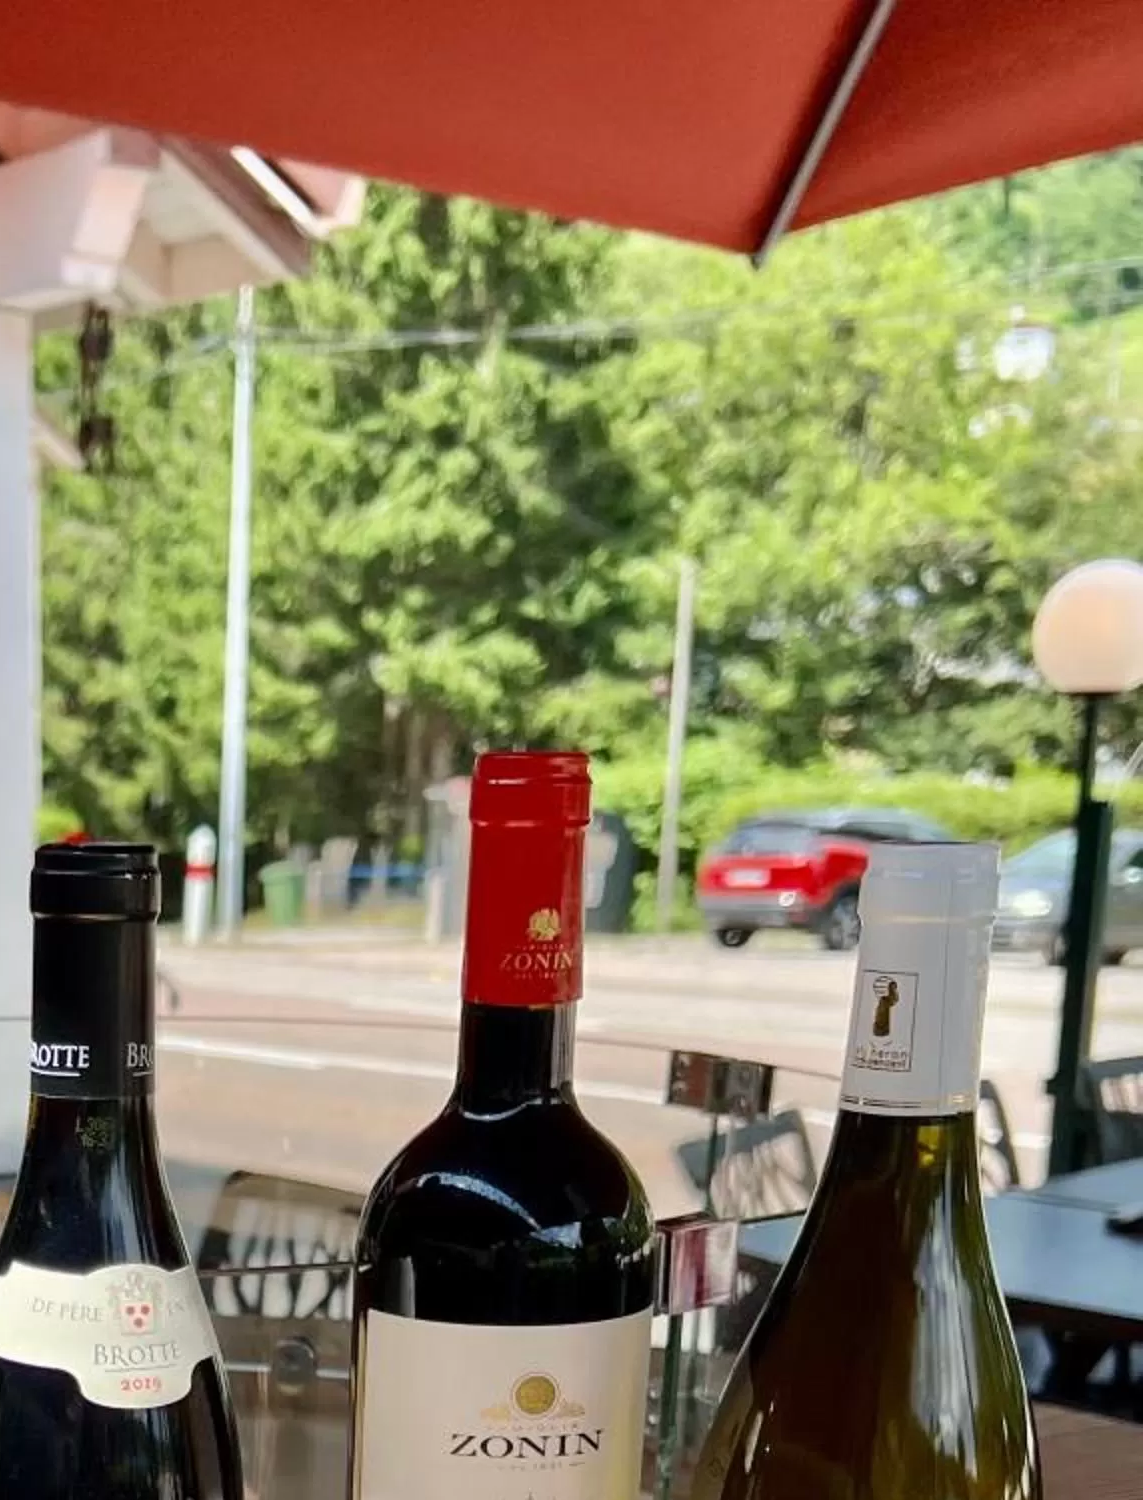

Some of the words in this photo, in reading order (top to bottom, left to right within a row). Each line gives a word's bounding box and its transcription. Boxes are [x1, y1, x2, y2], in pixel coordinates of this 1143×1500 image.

[500, 951, 574, 971] ZONIN
[93, 1340, 181, 1367] BROTTE
[450, 1428, 606, 1459] ZONIN
